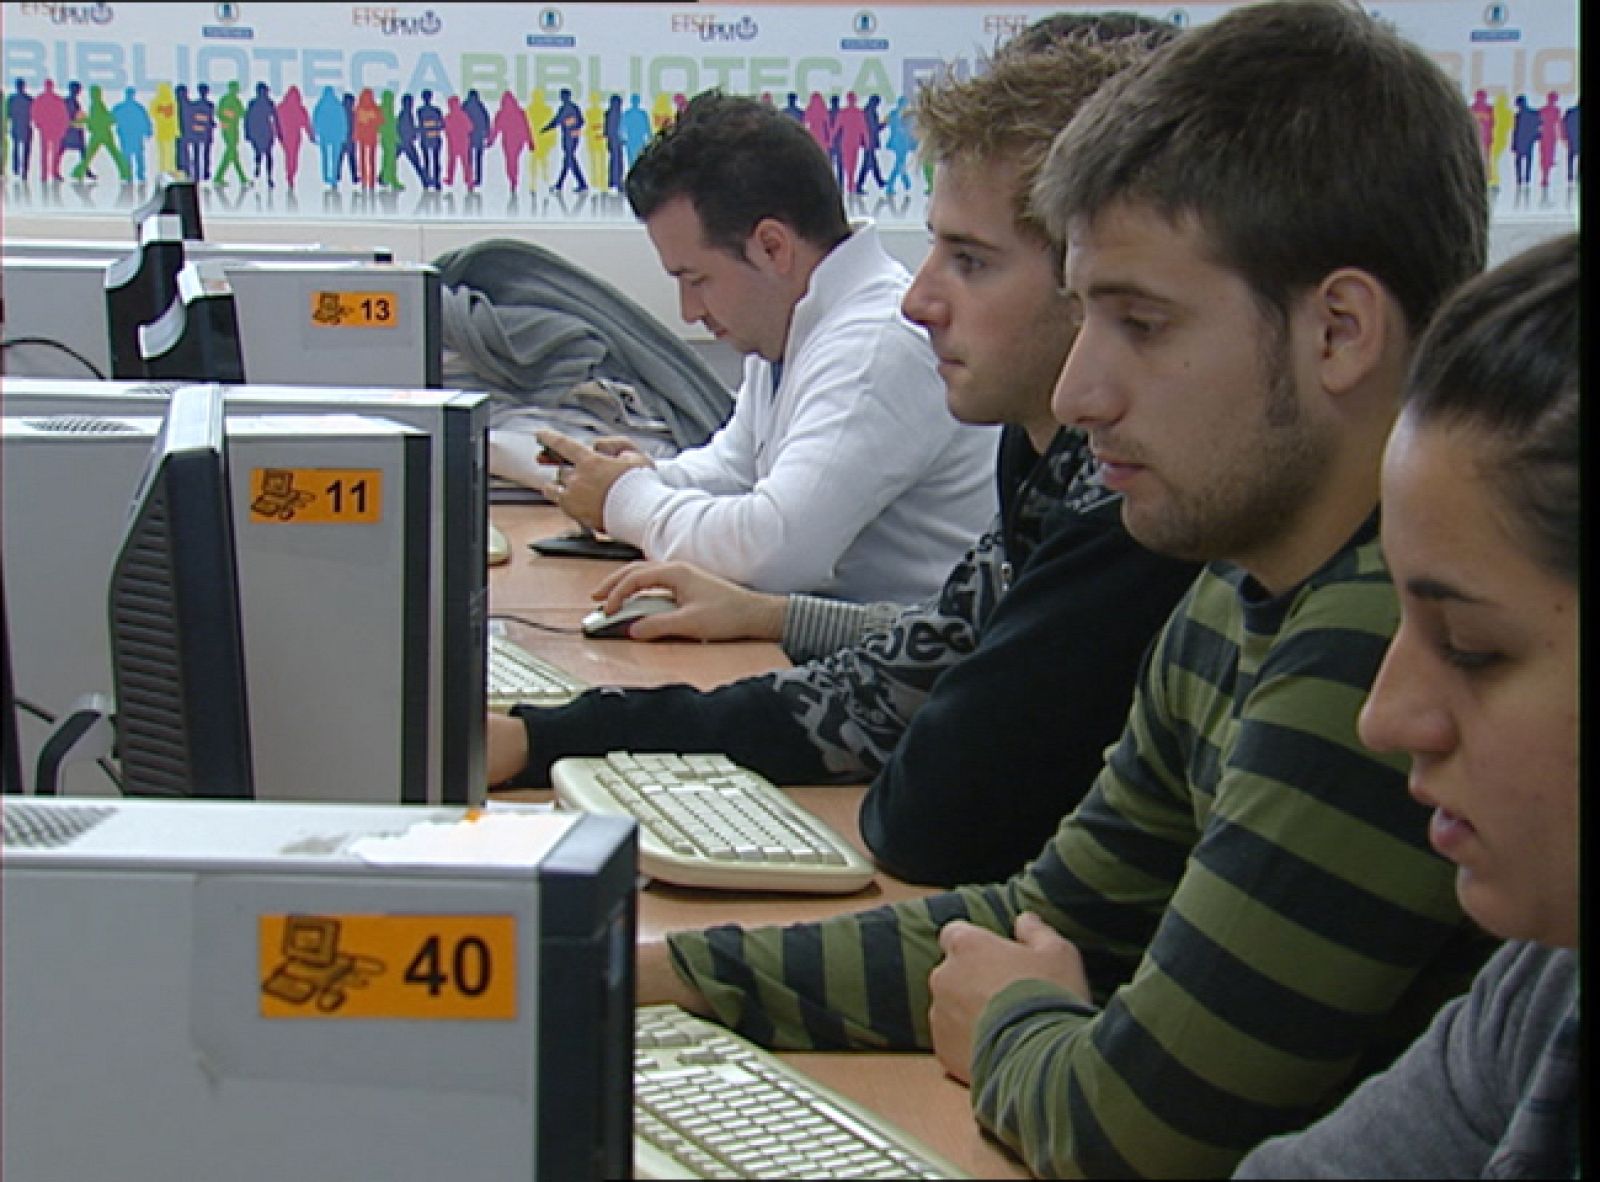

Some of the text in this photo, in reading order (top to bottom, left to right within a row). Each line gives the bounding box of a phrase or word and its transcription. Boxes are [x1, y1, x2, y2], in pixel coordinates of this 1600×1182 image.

[5, 38, 453, 97] BIBLIOTECA
[460, 53, 895, 101] BIBLIOTECA
[361, 298, 390, 321] 13
[325, 479, 368, 513] 11
[404, 934, 493, 998] 40
